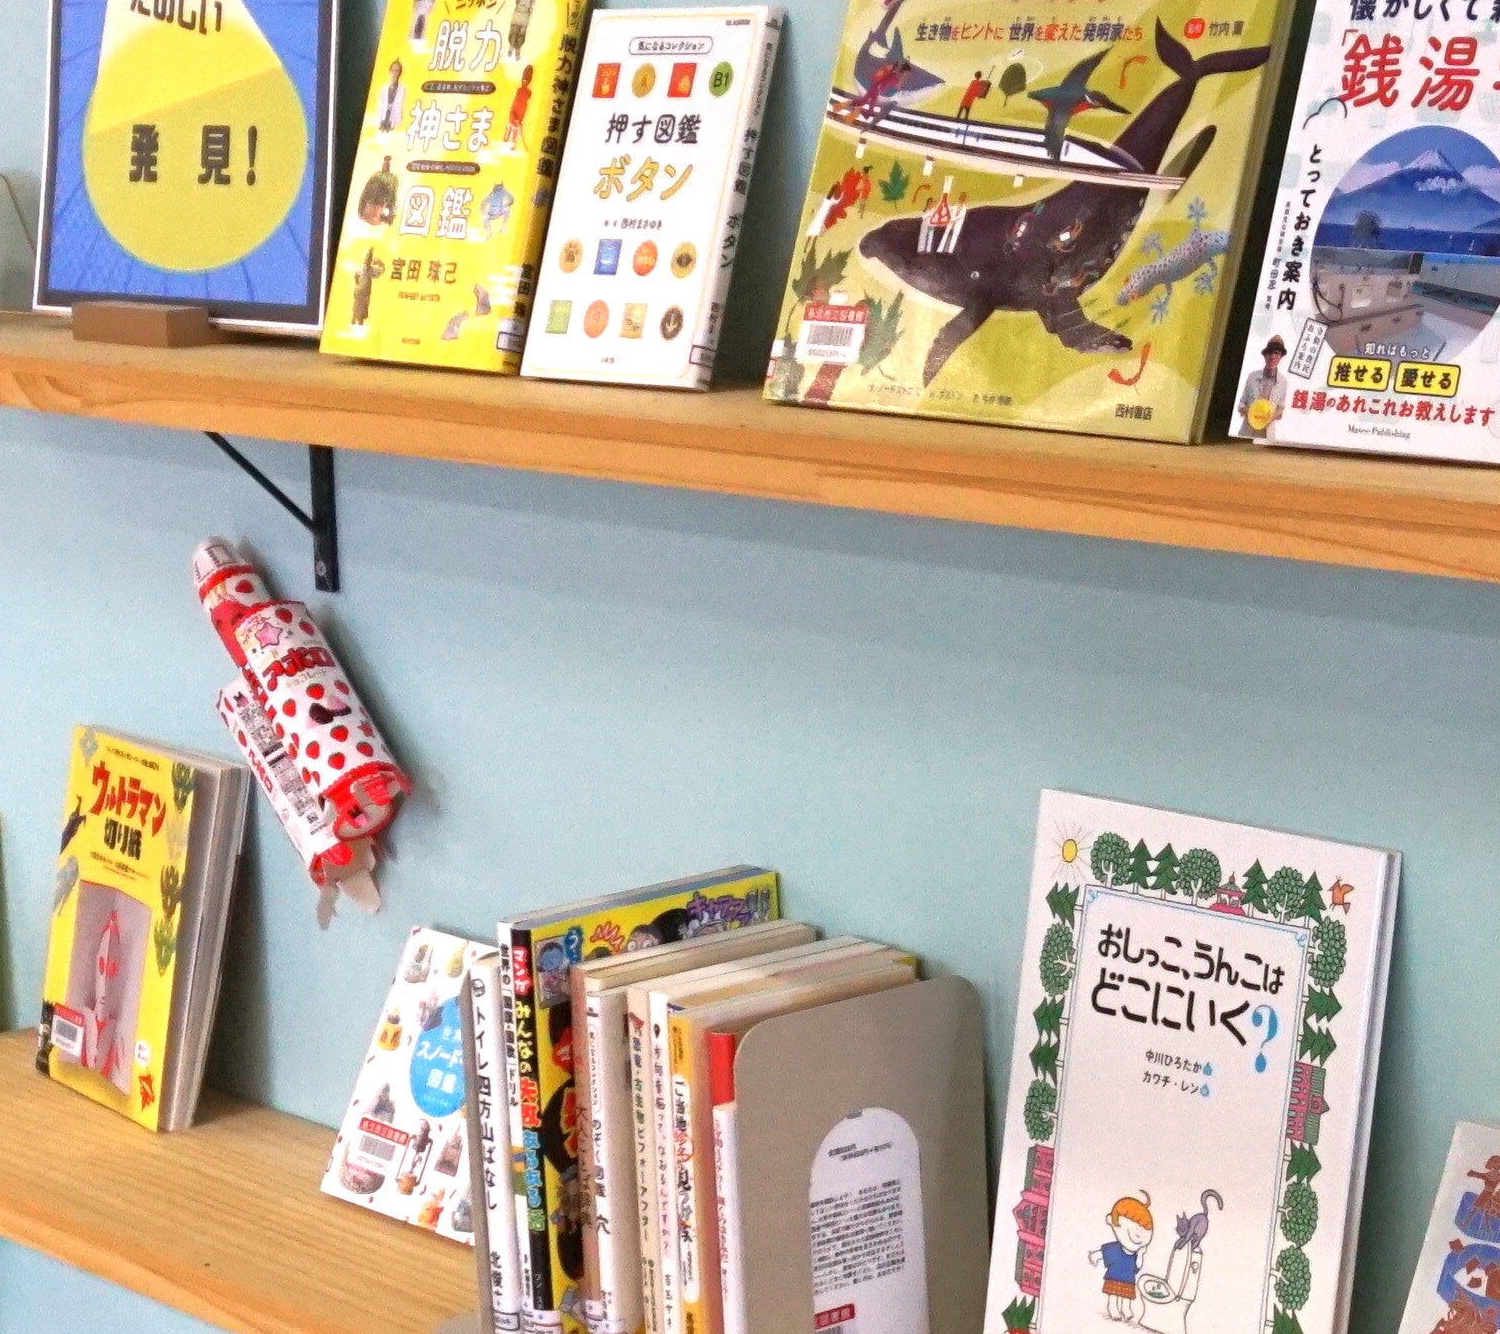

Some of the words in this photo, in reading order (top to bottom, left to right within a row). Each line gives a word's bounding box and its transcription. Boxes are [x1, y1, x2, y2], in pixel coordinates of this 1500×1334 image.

[428, 18, 503, 73] 脱力
[712, 71, 730, 89] B1
[405, 99, 494, 153] 神さま
[604, 113, 702, 145] 押す図鑑
[592, 153, 693, 203] ボタン
[398, 184, 475, 241] 図鑑
[1276, 143, 1323, 312] とっておき案内
[1333, 361, 1385, 385] 推せる
[1399, 367, 1453, 391] 愛せる
[1290, 388, 1496, 428] 銭湯のあれこれお教えします
[261, 646, 337, 692] アポロ
[88, 760, 167, 838] ウルトラマン
[104, 817, 143, 861] 切り紙
[1097, 923, 1286, 996] おしっこ、うんこは
[1090, 967, 1279, 1074] どこにいく?
[1142, 1069, 1199, 1096] カワチ・レン
[1144, 1048, 1201, 1074] 中川ひろたか
